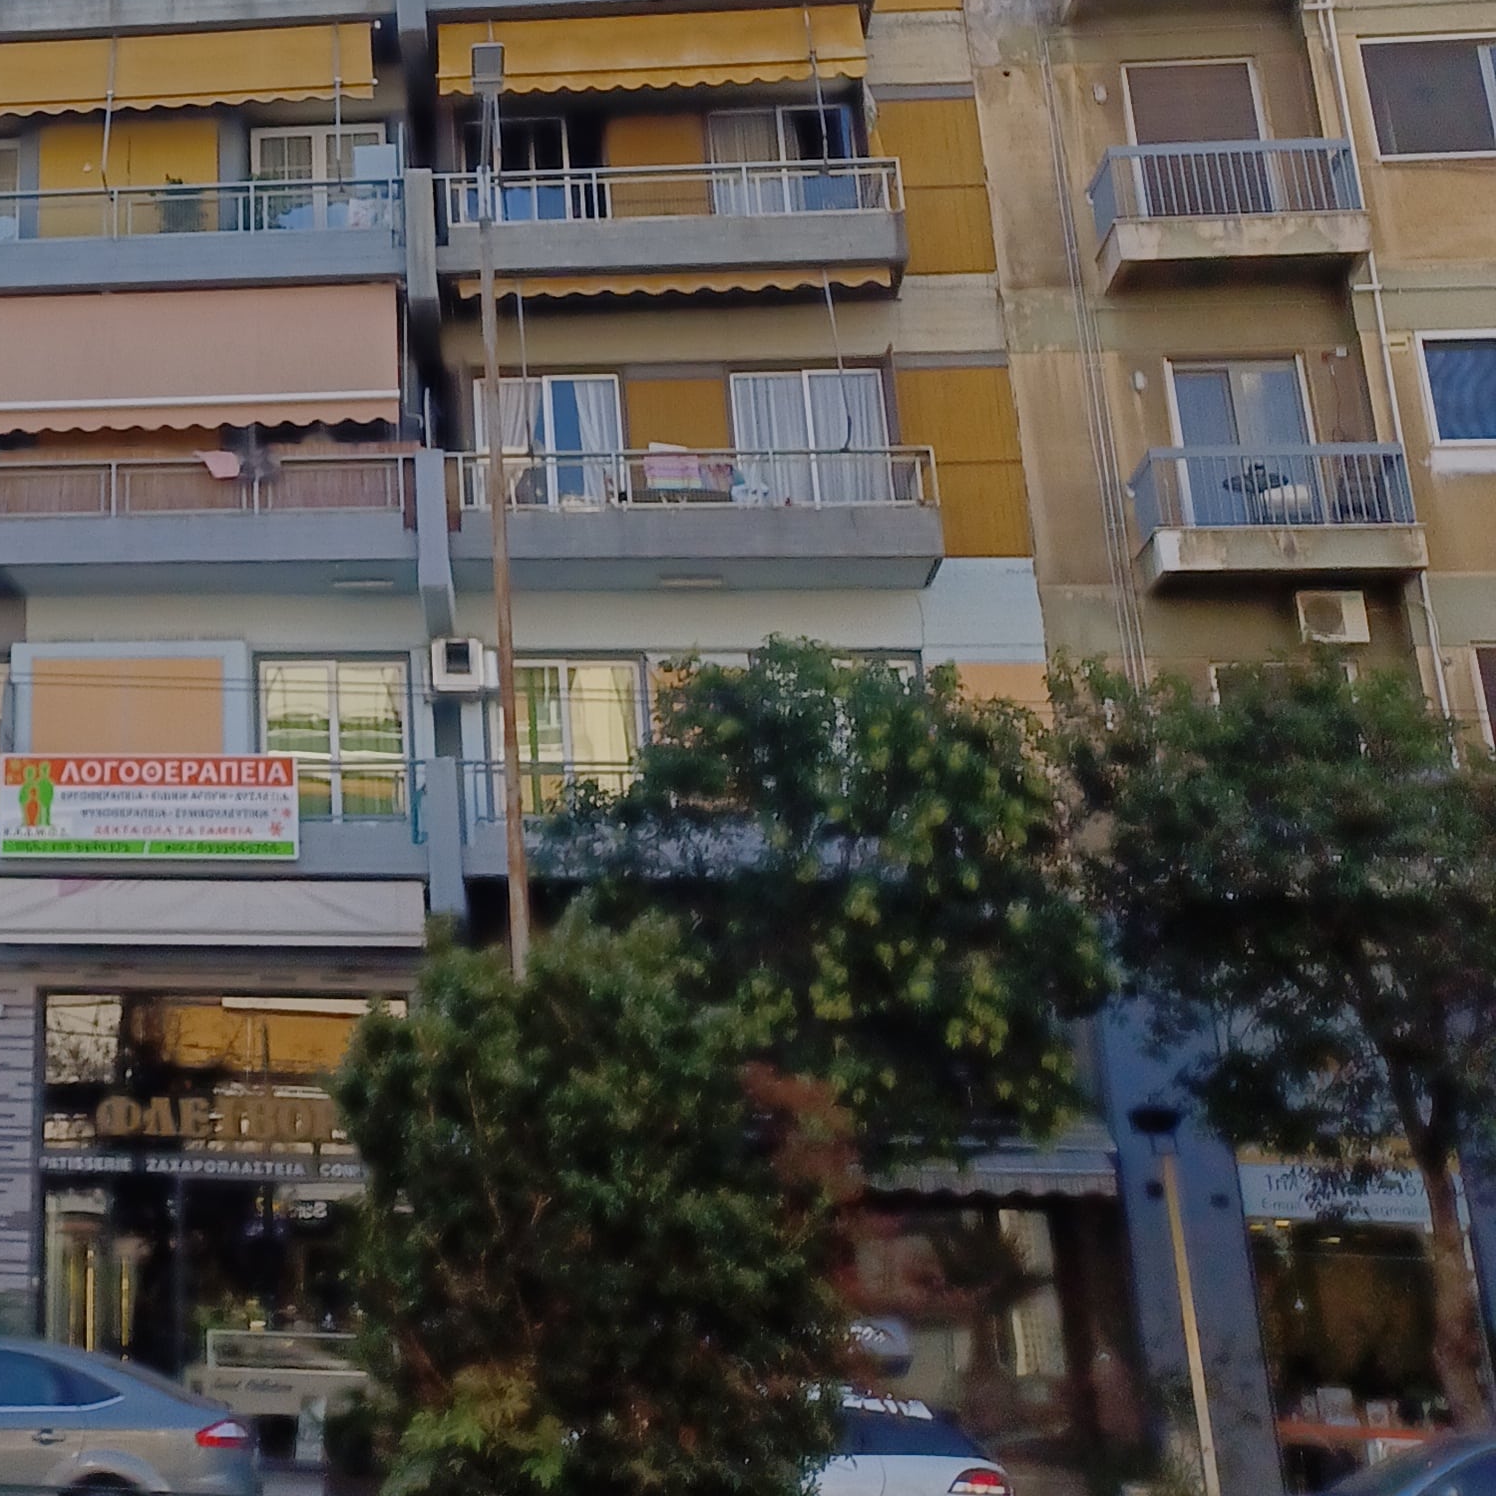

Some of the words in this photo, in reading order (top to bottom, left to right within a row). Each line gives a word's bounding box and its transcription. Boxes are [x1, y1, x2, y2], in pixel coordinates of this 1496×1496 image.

[60, 760, 288, 784] ΛΟΓΟΘΕΡΑΠΕΙΑ
[38, 1156, 133, 1173] PATISSERIE
[145, 1158, 307, 1177] ΖΑΧΑΡΟΠΛΑΣΤΕΙΑ
